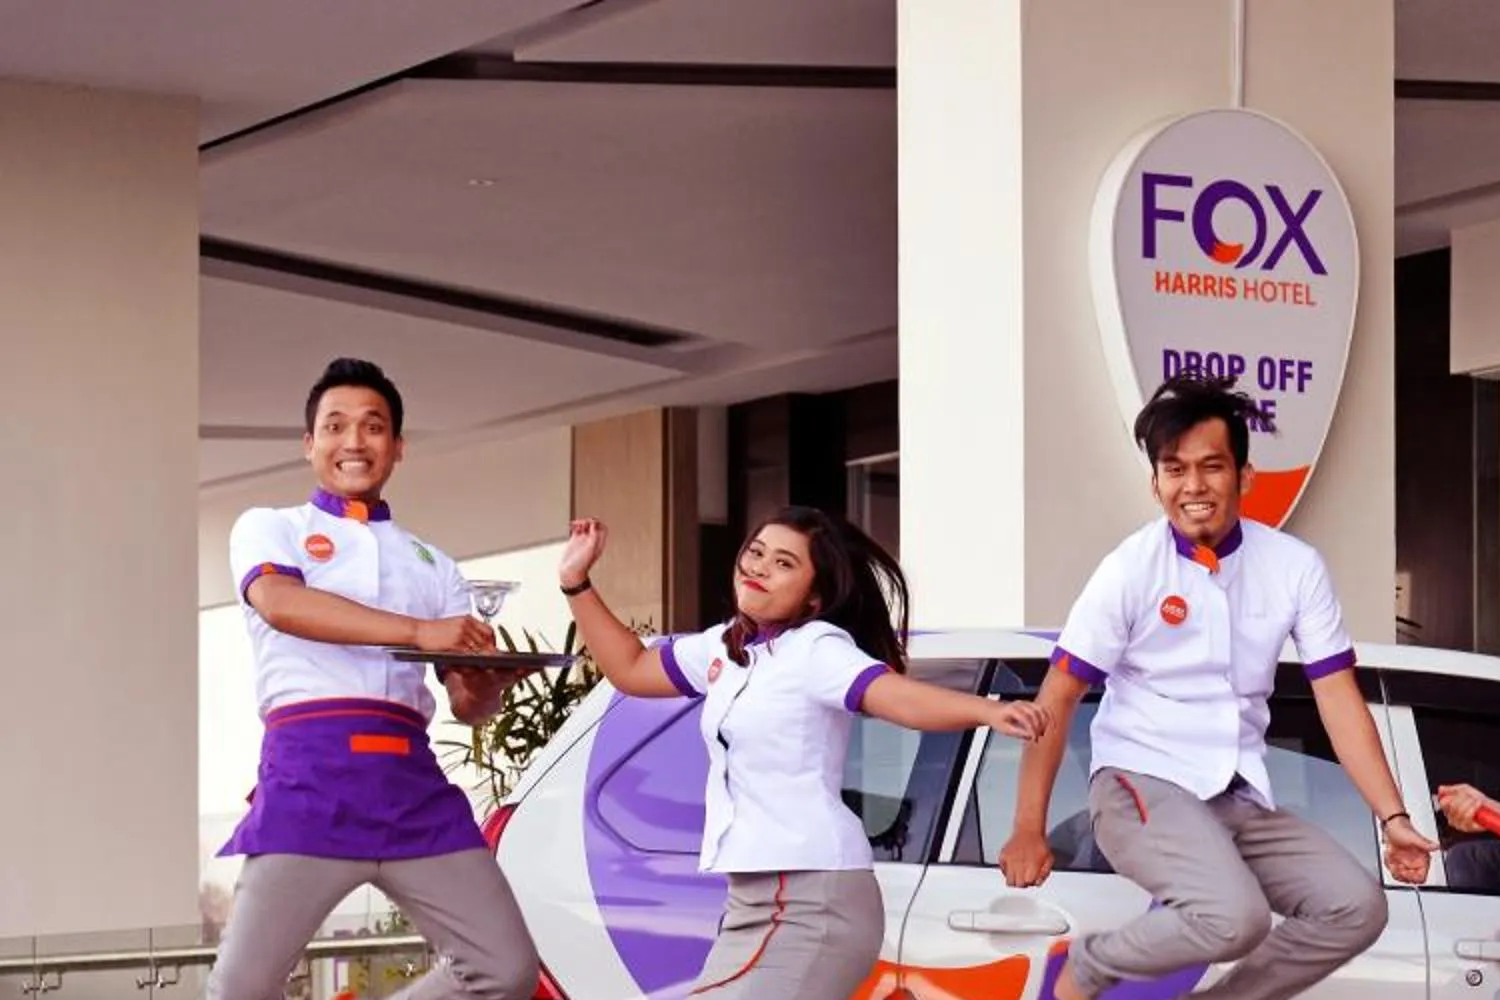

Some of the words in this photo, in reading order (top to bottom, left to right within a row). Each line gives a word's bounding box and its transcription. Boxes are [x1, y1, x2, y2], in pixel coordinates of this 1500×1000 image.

[1142, 172, 1328, 276] FOX
[1154, 270, 1238, 299] HARRIS
[1243, 279, 1318, 306] HOTEL
[1163, 349, 1246, 383] DROP
[1257, 356, 1313, 393] OFF
